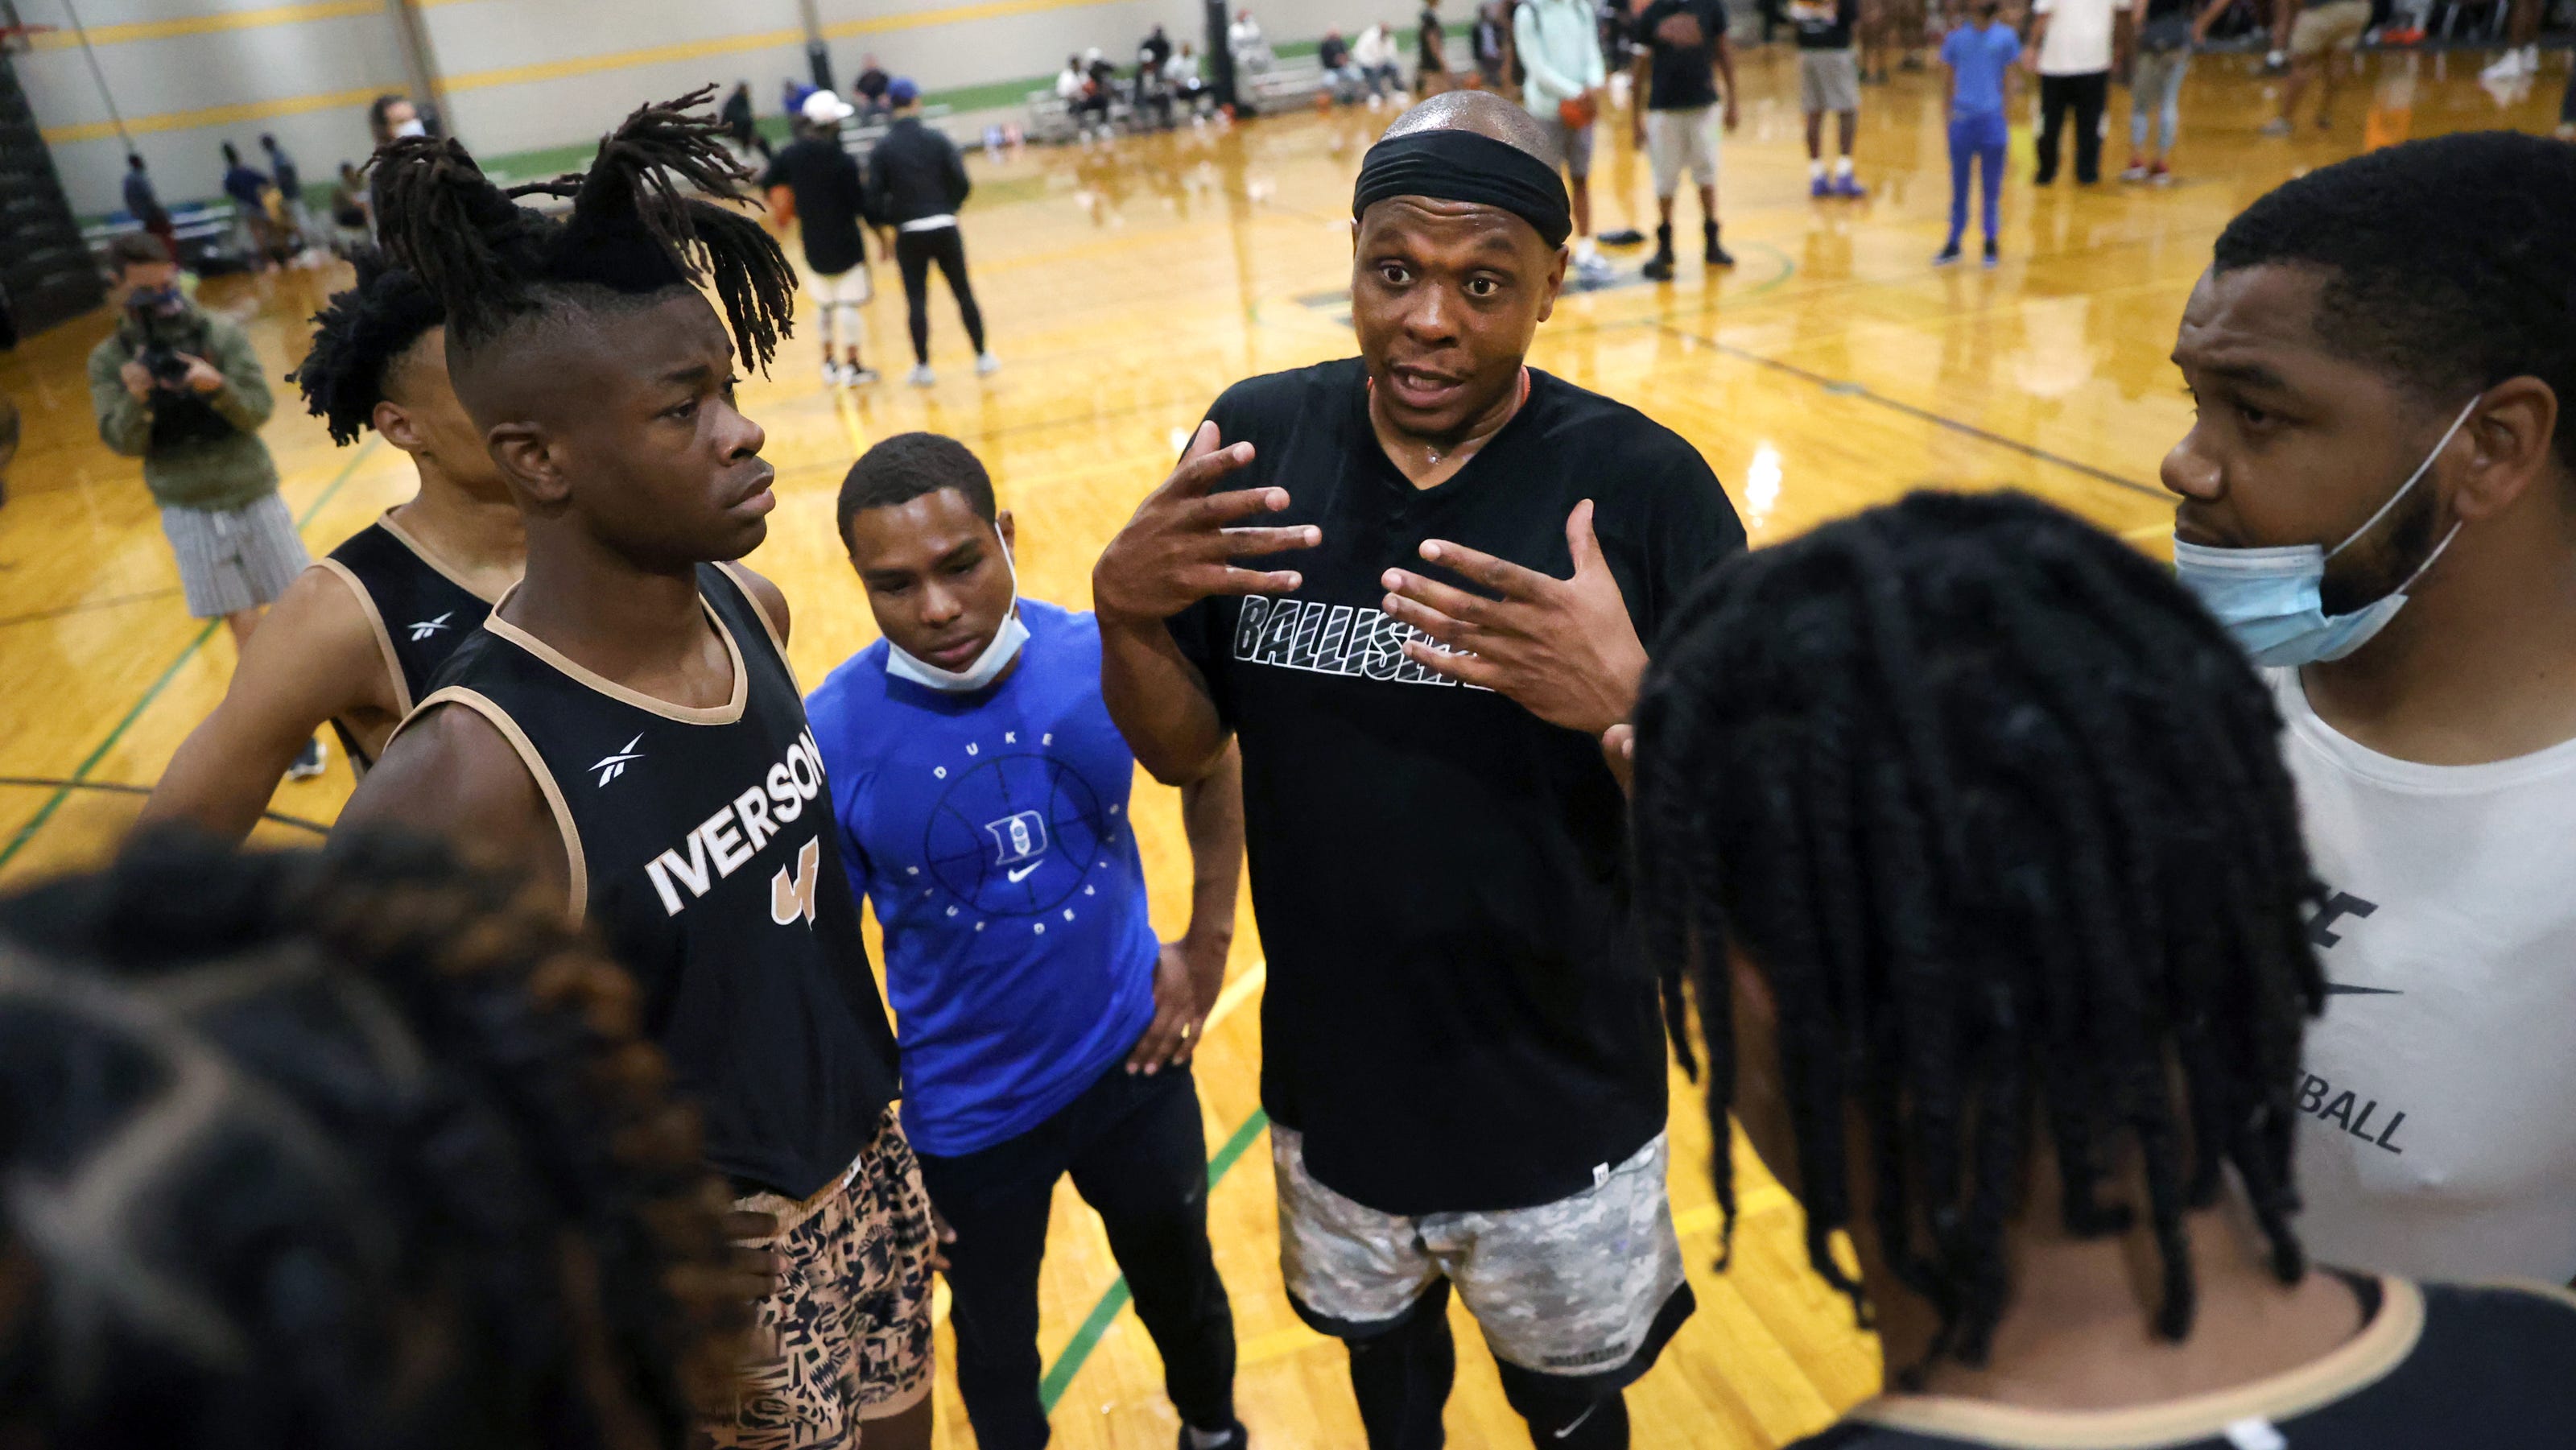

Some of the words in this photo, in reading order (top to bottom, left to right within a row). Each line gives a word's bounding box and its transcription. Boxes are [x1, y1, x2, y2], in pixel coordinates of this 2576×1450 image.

[933, 731, 1053, 779] DUKE
[644, 724, 826, 917] IVERSON
[770, 834, 819, 932] 4
[2297, 1067, 2407, 1155] BALL
